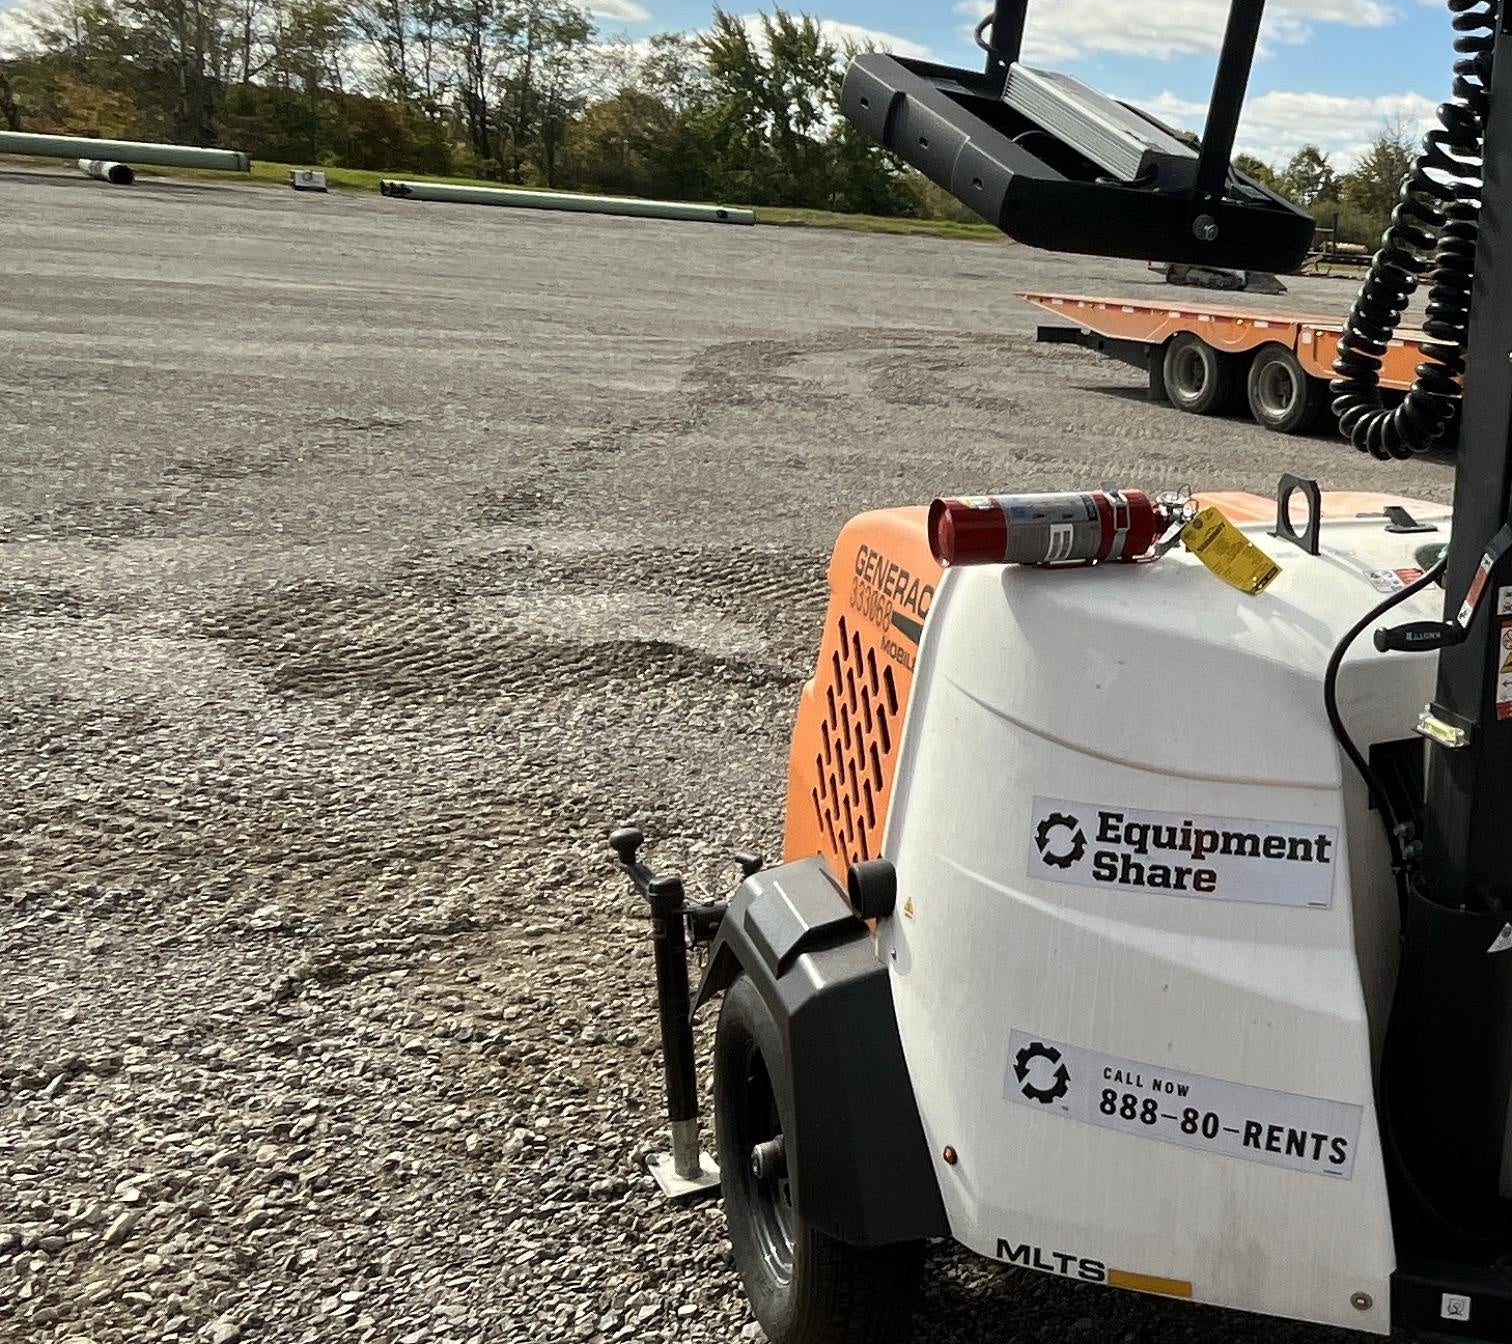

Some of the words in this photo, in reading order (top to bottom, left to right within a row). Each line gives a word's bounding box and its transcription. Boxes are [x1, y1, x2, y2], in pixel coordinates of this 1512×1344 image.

[854, 544, 935, 620] GENERAC
[881, 636, 917, 673] MOBIL
[1095, 811, 1332, 863] Equipment
[1092, 850, 1217, 893] Share
[1103, 1066, 1144, 1088] CALL
[1152, 1078, 1190, 1097] NOW
[1099, 1088, 1349, 1165] 888-80-RENTS
[996, 1237, 1106, 1282] MLTS
